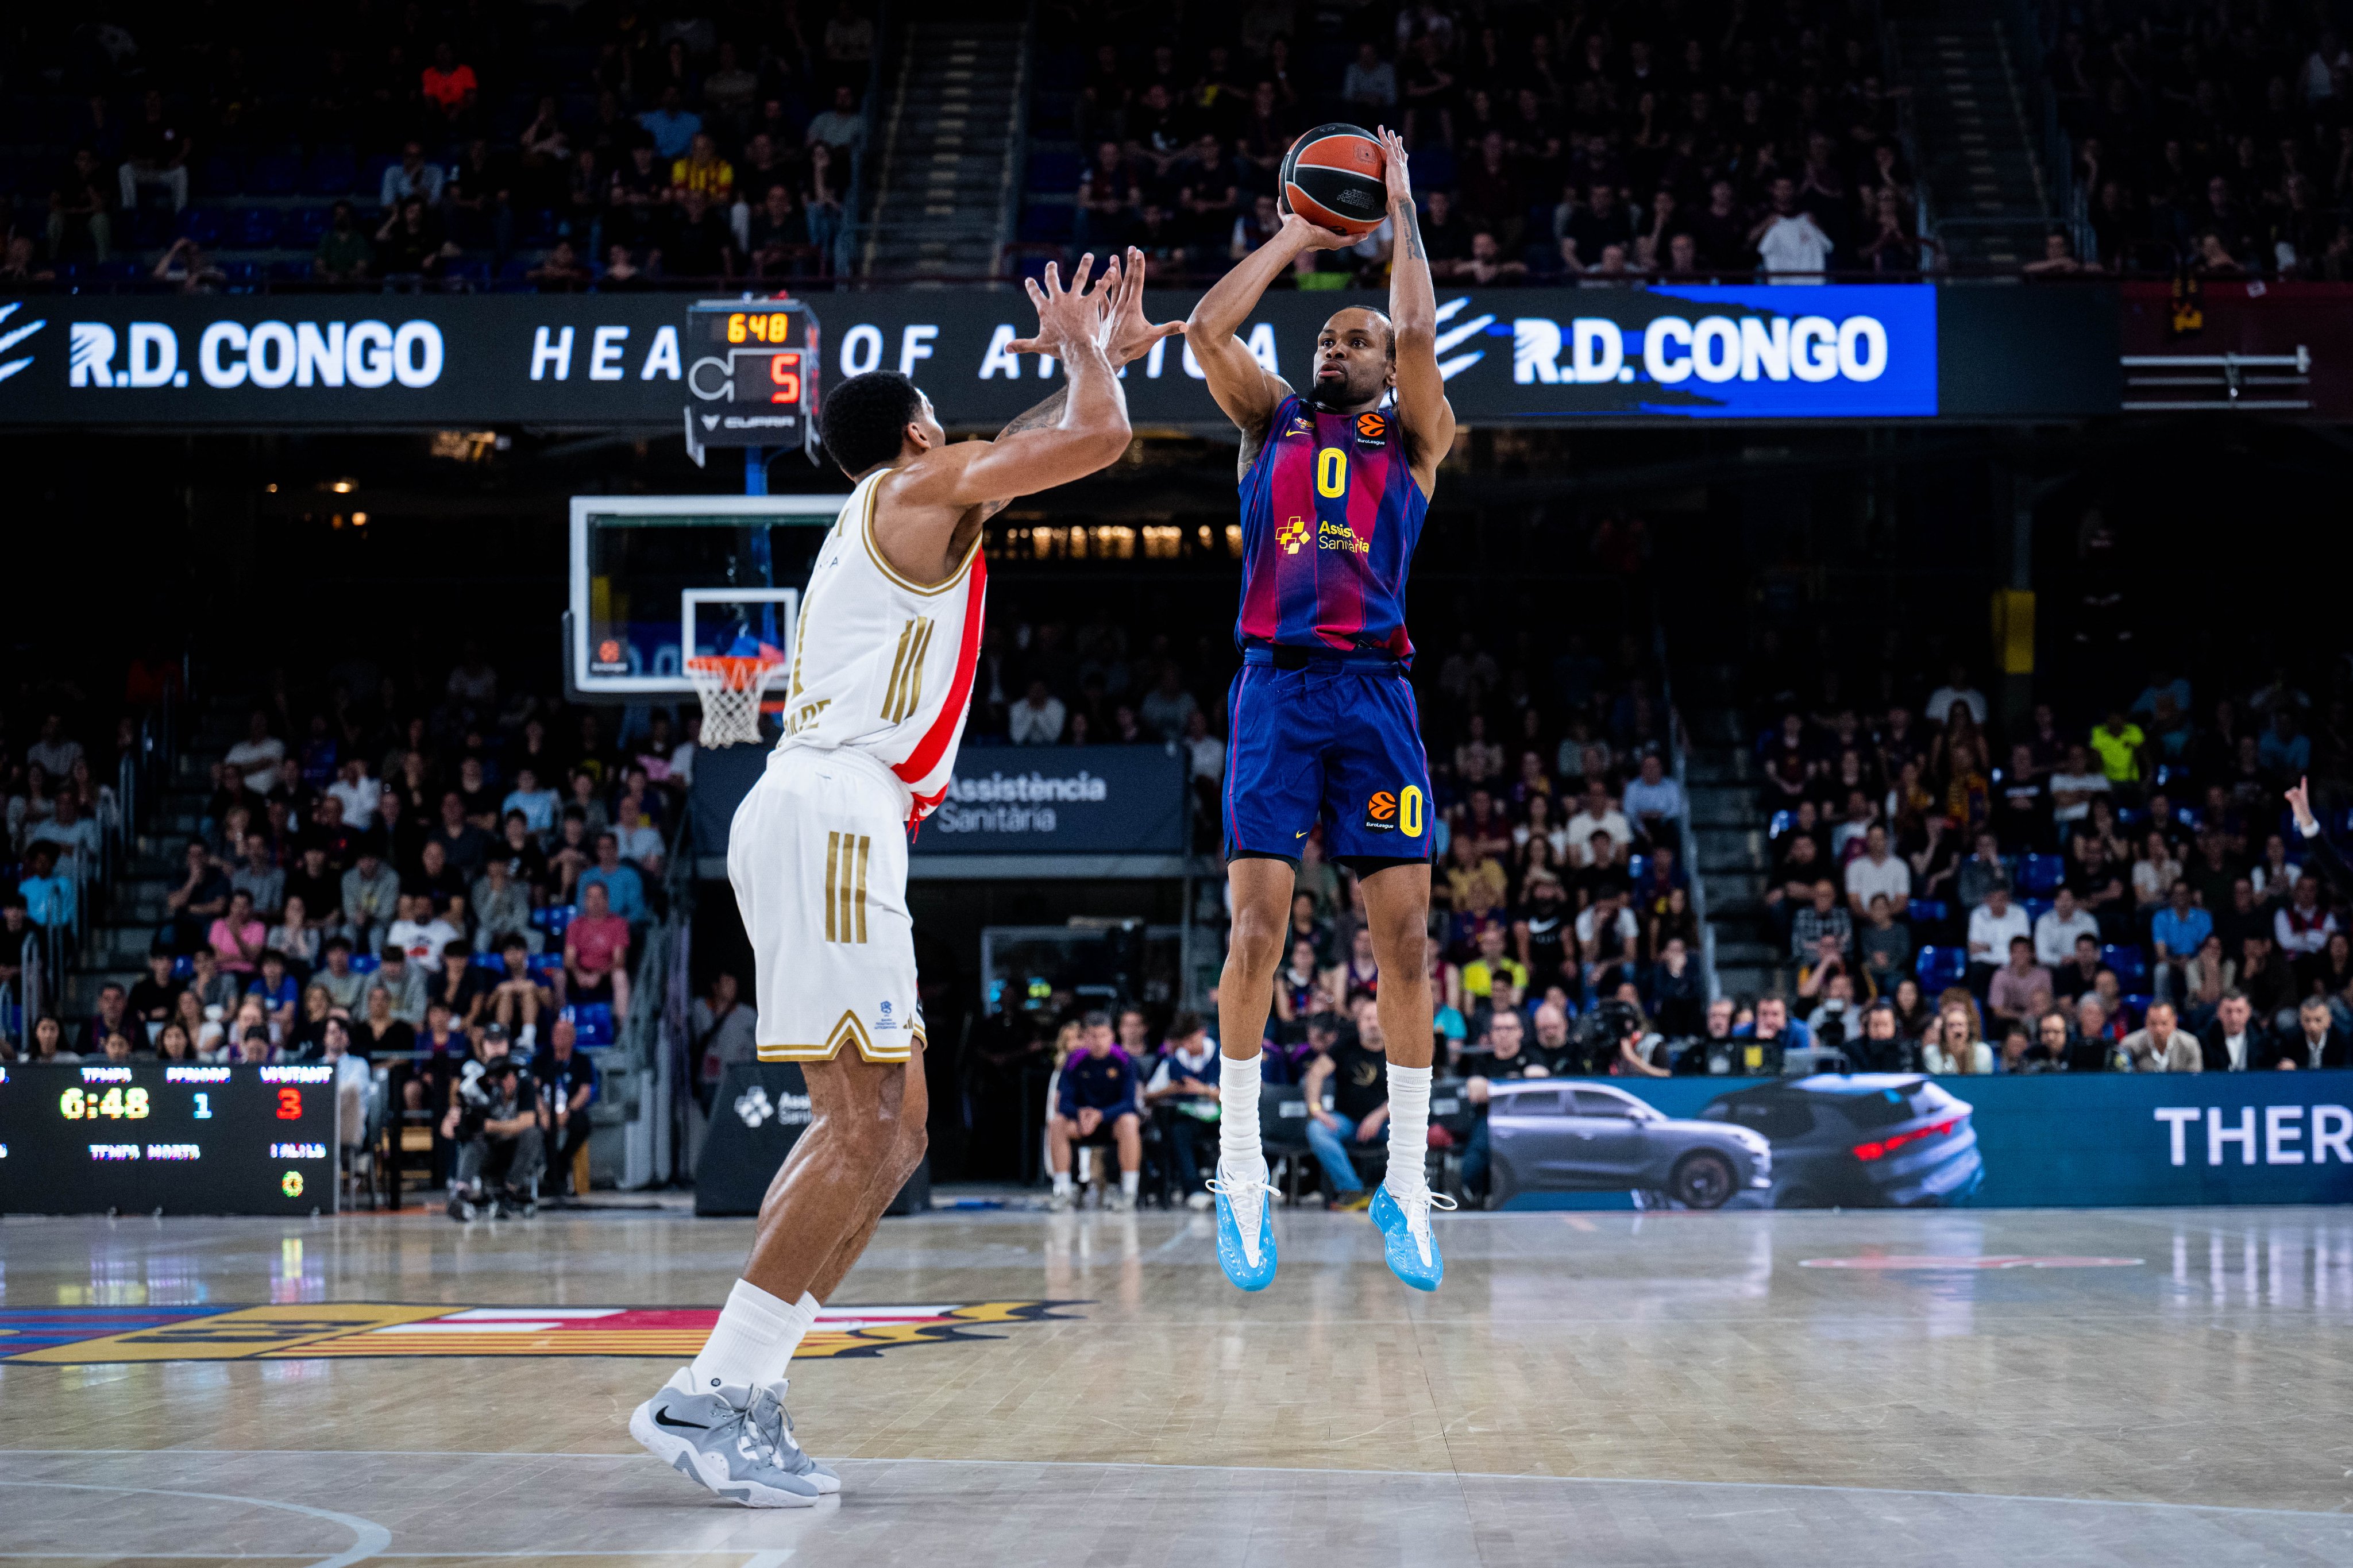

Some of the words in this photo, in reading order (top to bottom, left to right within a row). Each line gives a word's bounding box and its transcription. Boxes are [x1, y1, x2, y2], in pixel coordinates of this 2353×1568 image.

[70, 321, 188, 388] R.D.
[199, 319, 445, 388] CONGO
[530, 325, 682, 380] HEA
[839, 324, 939, 379] OF
[1513, 318, 1634, 384] R.D.
[1644, 315, 1888, 383] CONGO
[770, 353, 801, 403] 5
[1317, 447, 1347, 498] 0
[1400, 785, 1423, 837] 0
[60, 1087, 149, 1120] 6:48
[193, 1092, 212, 1118] 1
[276, 1087, 302, 1120] 3
[2154, 1104, 2353, 1166] THER
